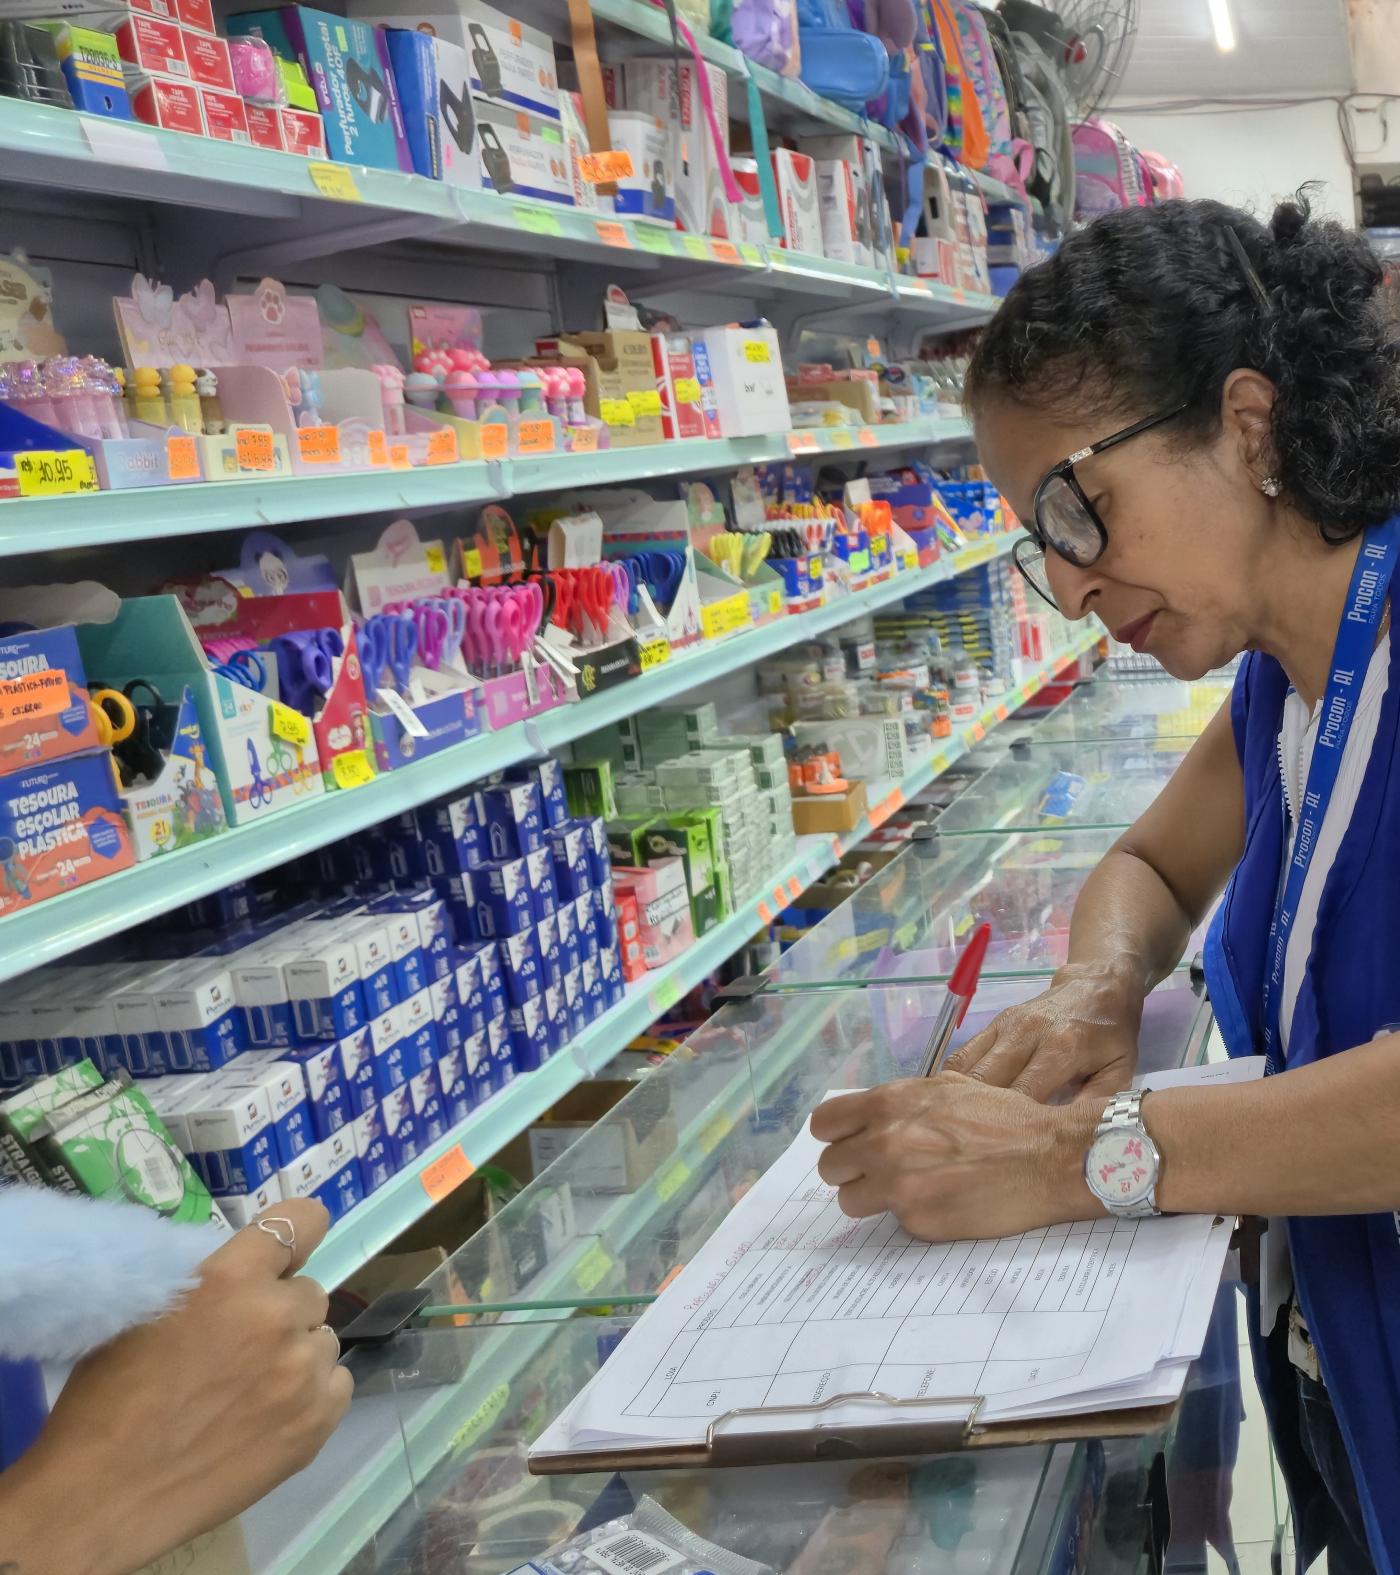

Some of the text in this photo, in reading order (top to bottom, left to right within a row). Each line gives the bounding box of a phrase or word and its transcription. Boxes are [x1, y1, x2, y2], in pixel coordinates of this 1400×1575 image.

[317, 21, 341, 68] metal
[330, 73, 355, 155] perfurador
[1347, 570, 1379, 623] Procon
[1364, 543, 1388, 559] AL
[1319, 697, 1346, 748] Procon
[1333, 669, 1354, 686] AL
[1294, 818, 1314, 869] Procon
[1307, 791, 1321, 809] AL
[1272, 936, 1284, 985] Procon
